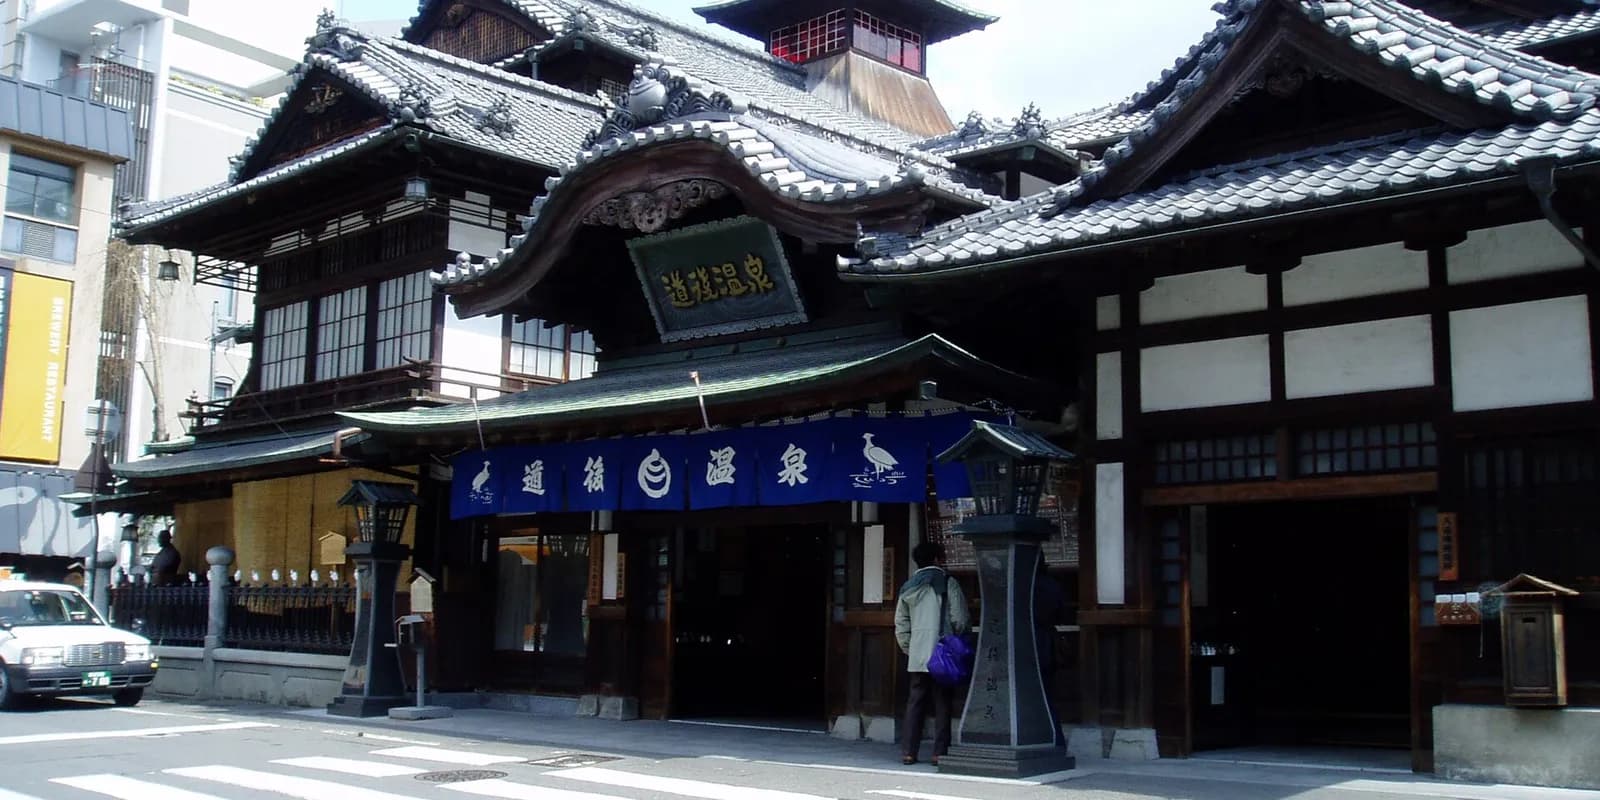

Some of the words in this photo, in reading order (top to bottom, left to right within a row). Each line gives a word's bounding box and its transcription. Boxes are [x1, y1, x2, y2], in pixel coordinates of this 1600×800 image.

[661, 253, 774, 309] 道後温泉
[49, 298, 63, 354] BREWERY
[42, 363, 58, 442] RESTAURANT
[521, 443, 809, 496] 道後温泉
